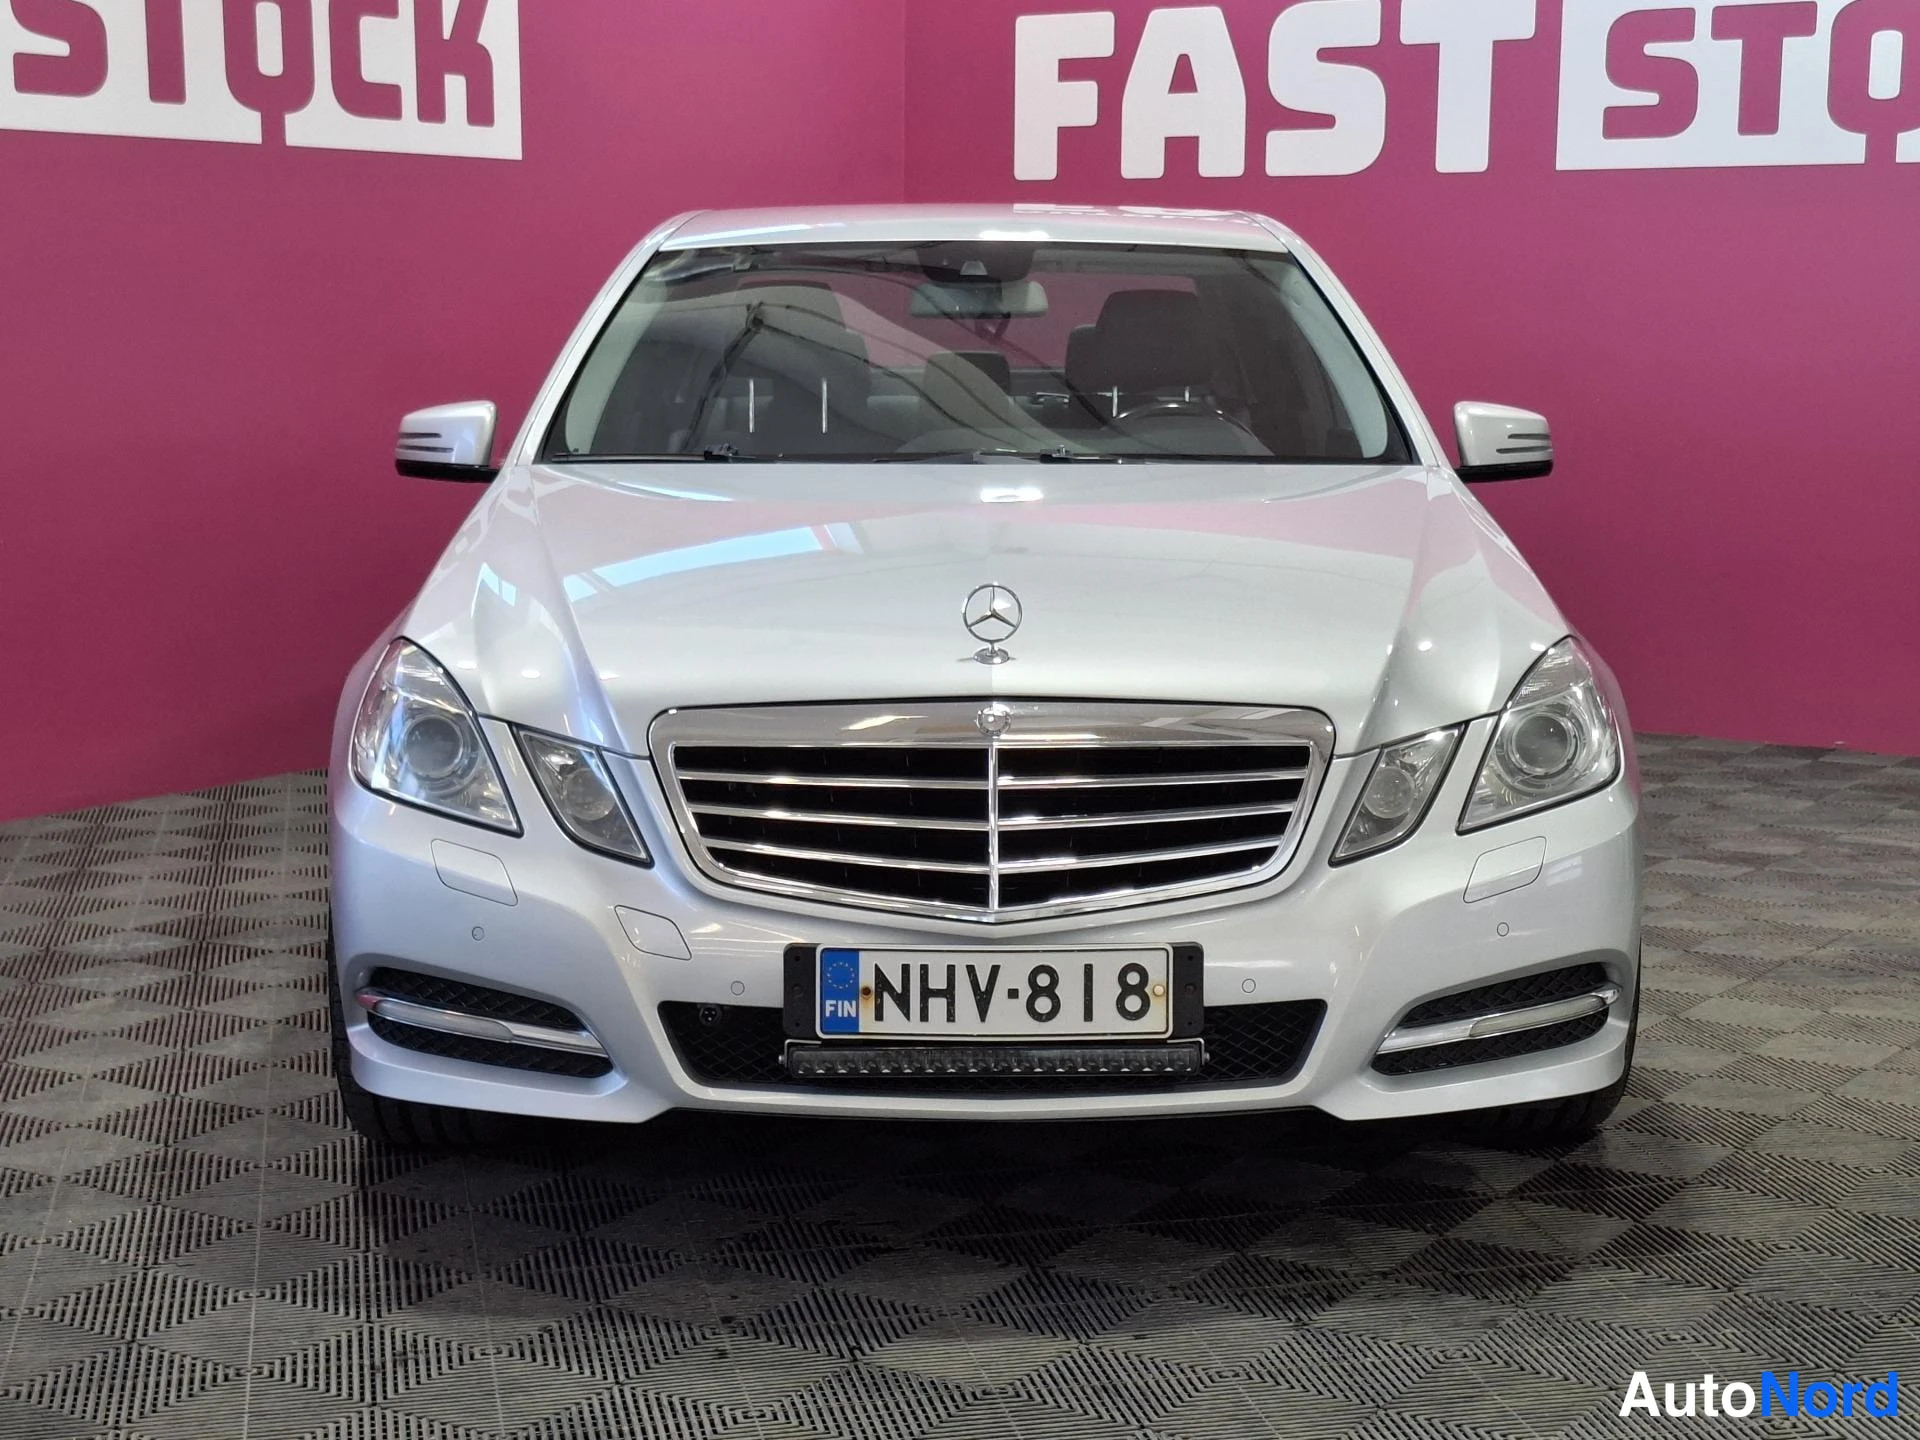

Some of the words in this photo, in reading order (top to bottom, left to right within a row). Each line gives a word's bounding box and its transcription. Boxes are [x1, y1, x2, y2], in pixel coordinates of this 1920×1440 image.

[1014, 0, 1537, 180] FAST
[824, 1000, 857, 1018] FIN
[873, 962, 1151, 1023] NHV-818
